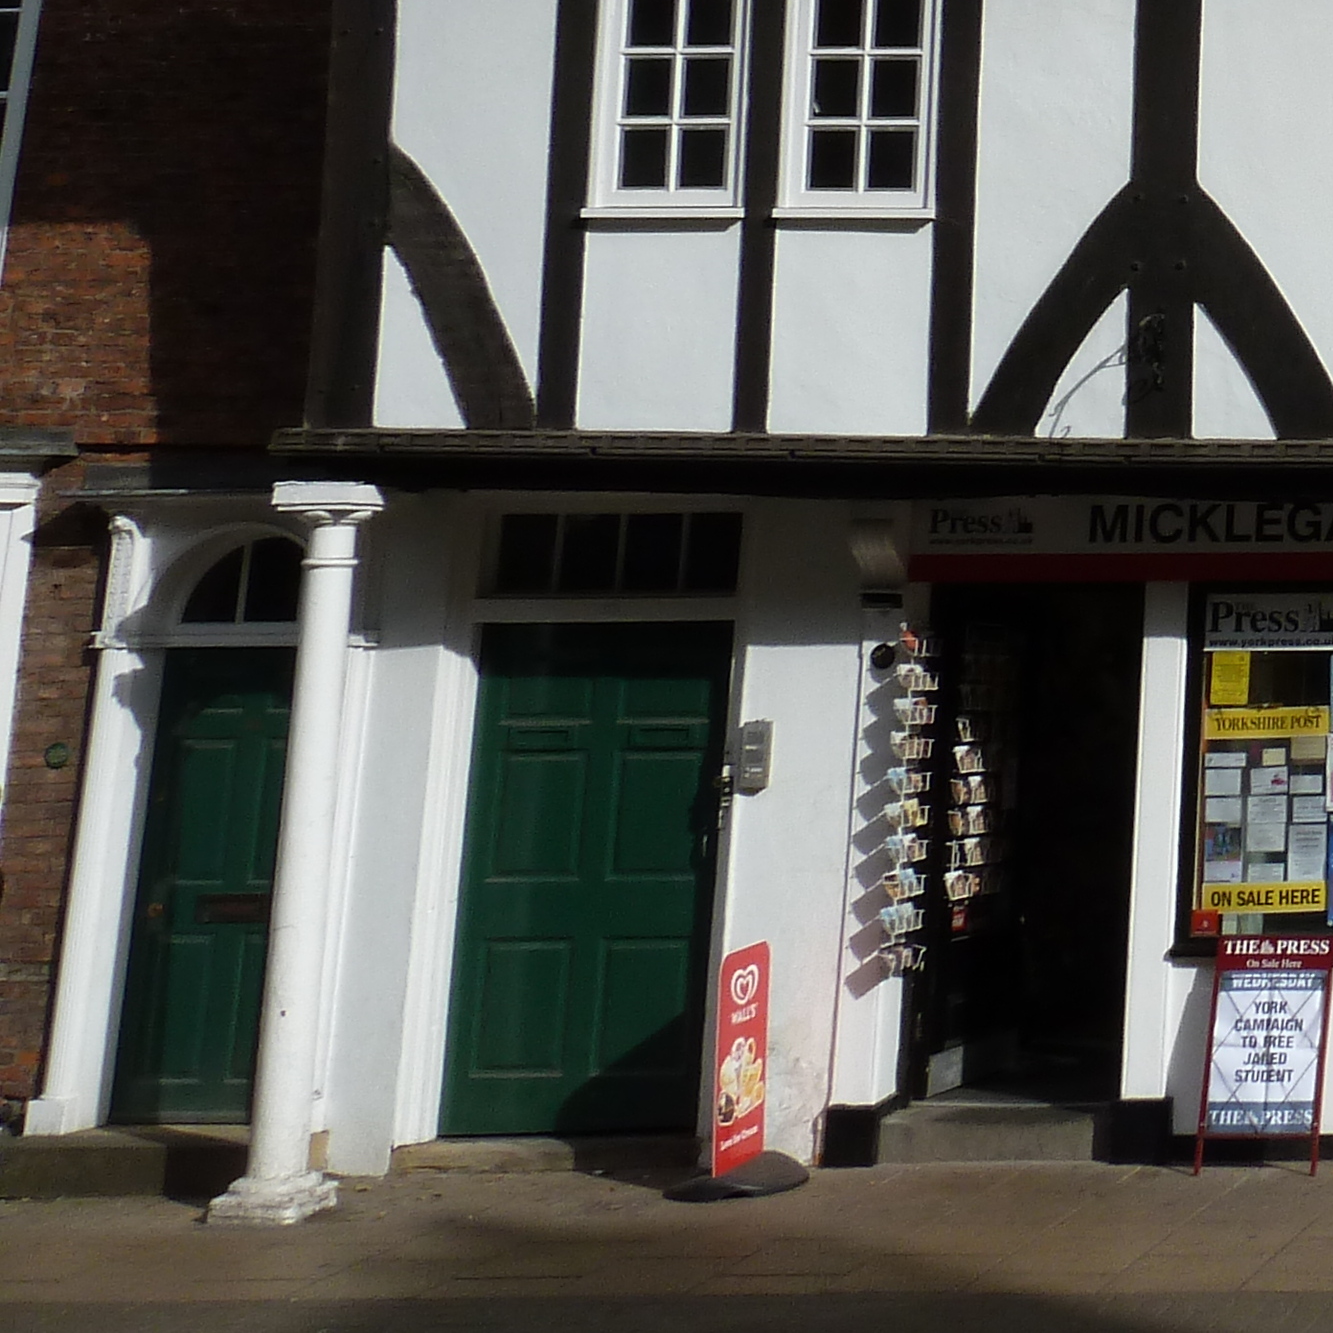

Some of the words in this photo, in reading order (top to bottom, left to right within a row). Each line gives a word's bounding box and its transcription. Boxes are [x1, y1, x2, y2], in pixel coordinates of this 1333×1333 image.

[929, 509, 1001, 534] Press
[1208, 601, 1300, 634] Press
[1215, 716, 1288, 732] YORKSHIRE
[1290, 715, 1322, 730] POST
[1210, 891, 1232, 908] ON
[1237, 890, 1274, 907] SALE
[1279, 888, 1321, 905] HERE
[1224, 940, 1260, 955] THE
[1276, 939, 1330, 955] PRESS
[1246, 958, 1260, 968] On
[1261, 958, 1280, 968] Sale
[1281, 958, 1302, 968] Here
[1254, 1001, 1288, 1015] YORK
[1234, 1018, 1304, 1032] CAMPAIGN
[1241, 1035, 1257, 1049] TO
[1263, 1035, 1295, 1049] FREE
[1234, 1069, 1295, 1083] STUDENT
[1209, 1110, 1243, 1125] THE
[1260, 1109, 1313, 1125] PRESS
